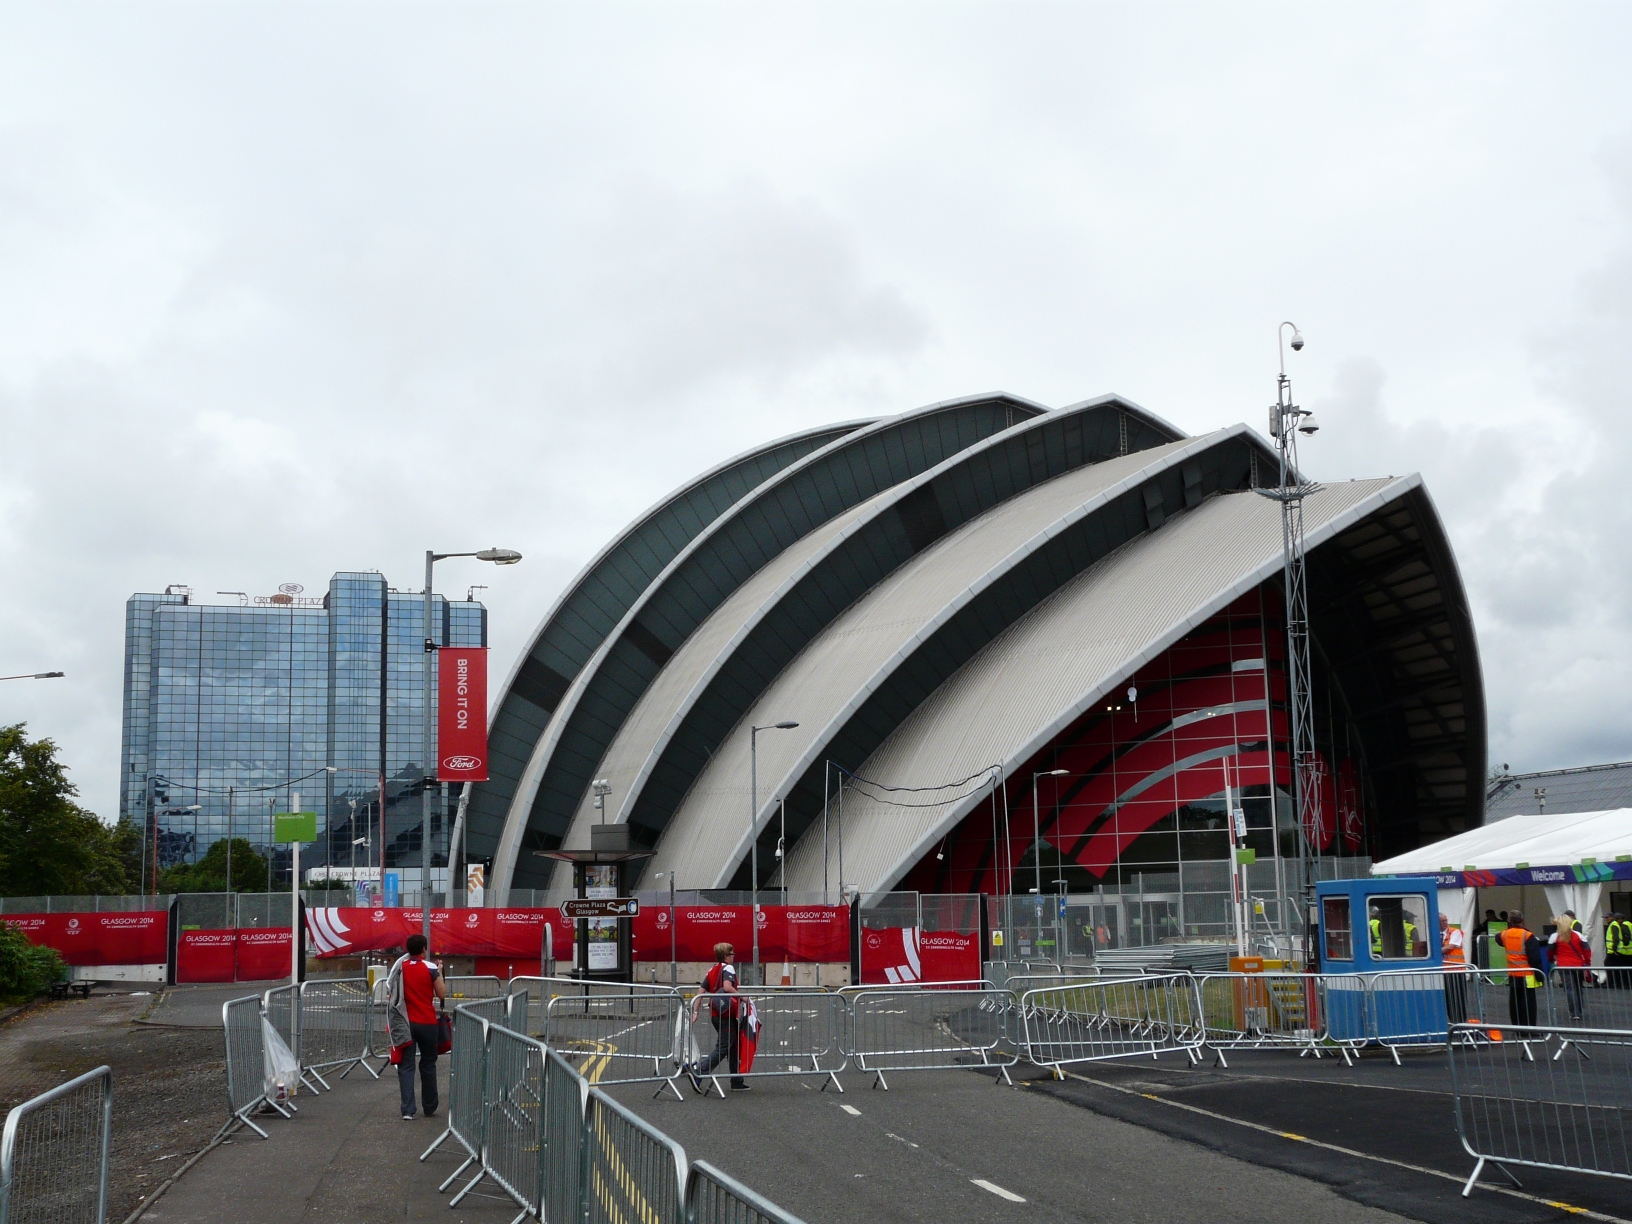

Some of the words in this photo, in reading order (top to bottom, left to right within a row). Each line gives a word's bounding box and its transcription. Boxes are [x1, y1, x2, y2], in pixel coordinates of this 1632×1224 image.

[457, 658, 468, 695] BRING
[457, 698, 468, 708] IT
[457, 710, 468, 729] ON
[449, 757, 475, 768] Ford
[1530, 869, 1565, 882] Welcome
[786, 911, 820, 919] GLASGOW
[920, 937, 954, 945] GLASGOW
